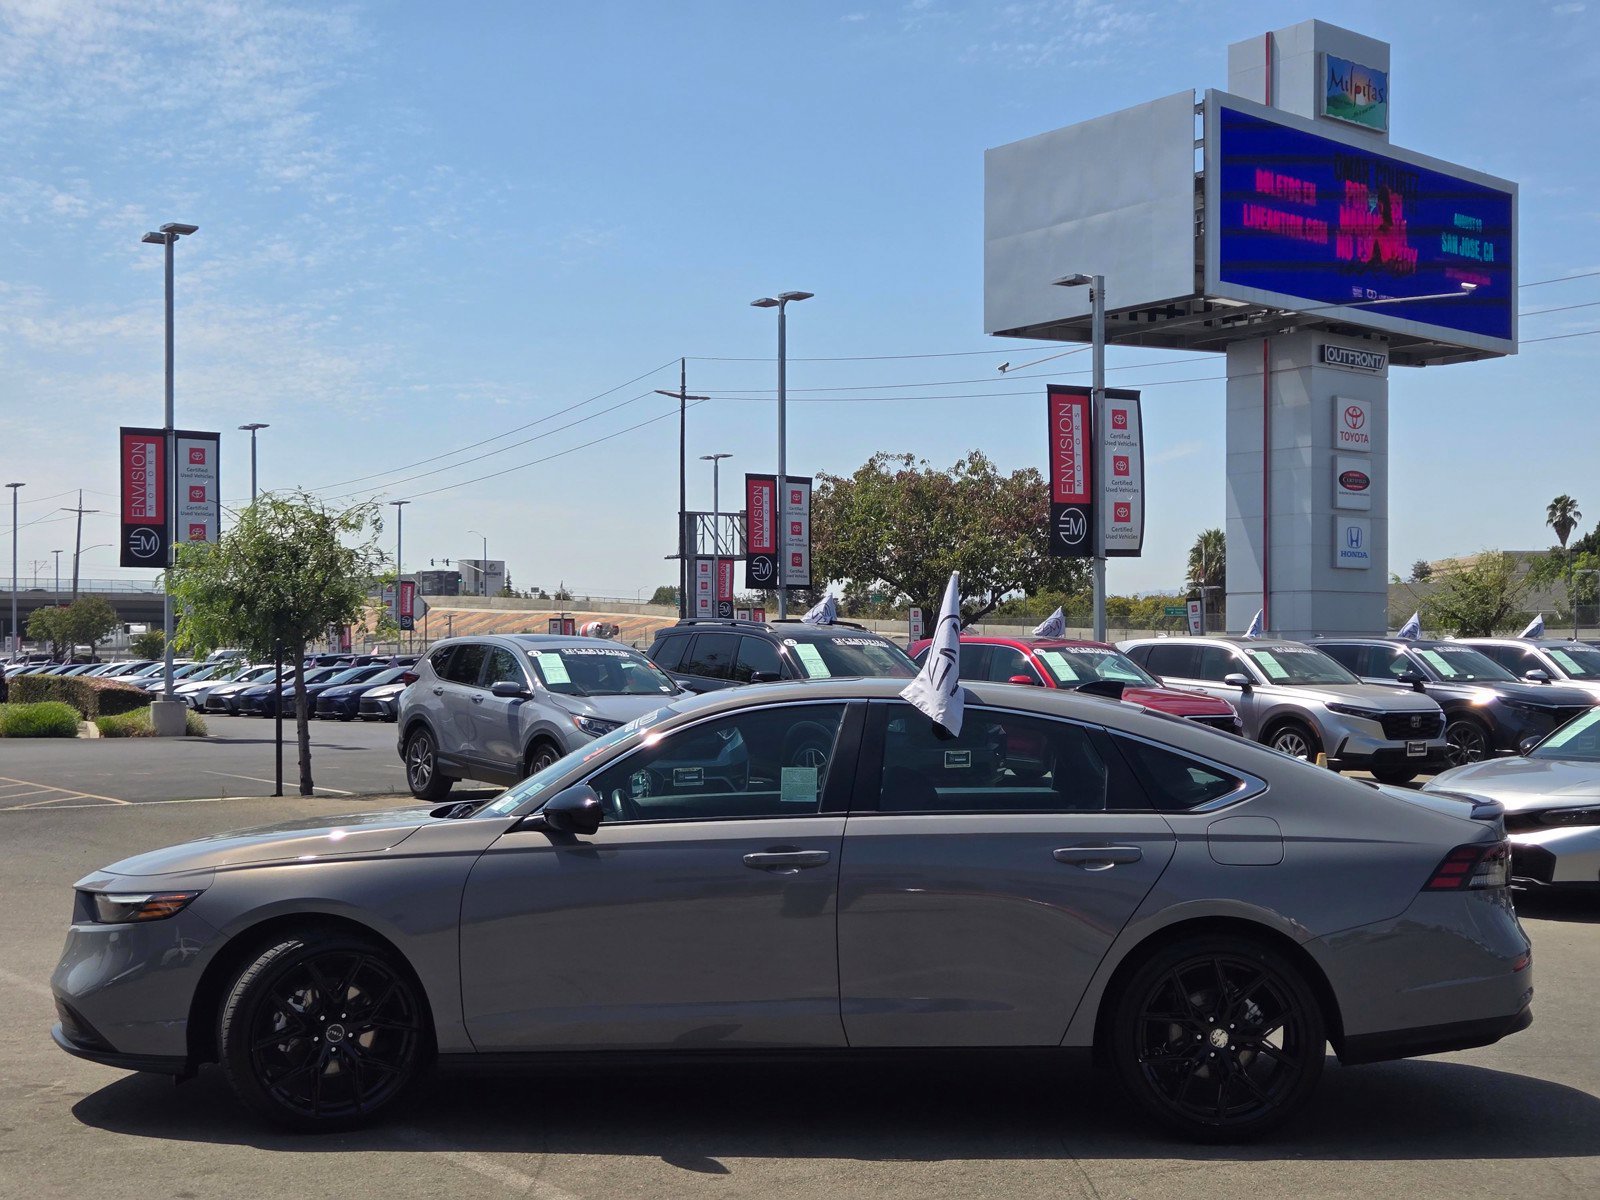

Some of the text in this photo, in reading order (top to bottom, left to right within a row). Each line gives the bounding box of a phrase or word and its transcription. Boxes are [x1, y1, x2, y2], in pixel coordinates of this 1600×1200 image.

[1328, 66, 1384, 108] Milpitas
[1442, 232, 1458, 254] SAN
[1460, 237, 1482, 262] JOSE,
[1484, 241, 1494, 262] CA
[1059, 403, 1074, 494] ENVISION
[1340, 431, 1369, 443] TOYOTA
[131, 442, 145, 517] ENVISION
[753, 486, 763, 548] ENVISION
[1340, 550, 1369, 559] HONDA
